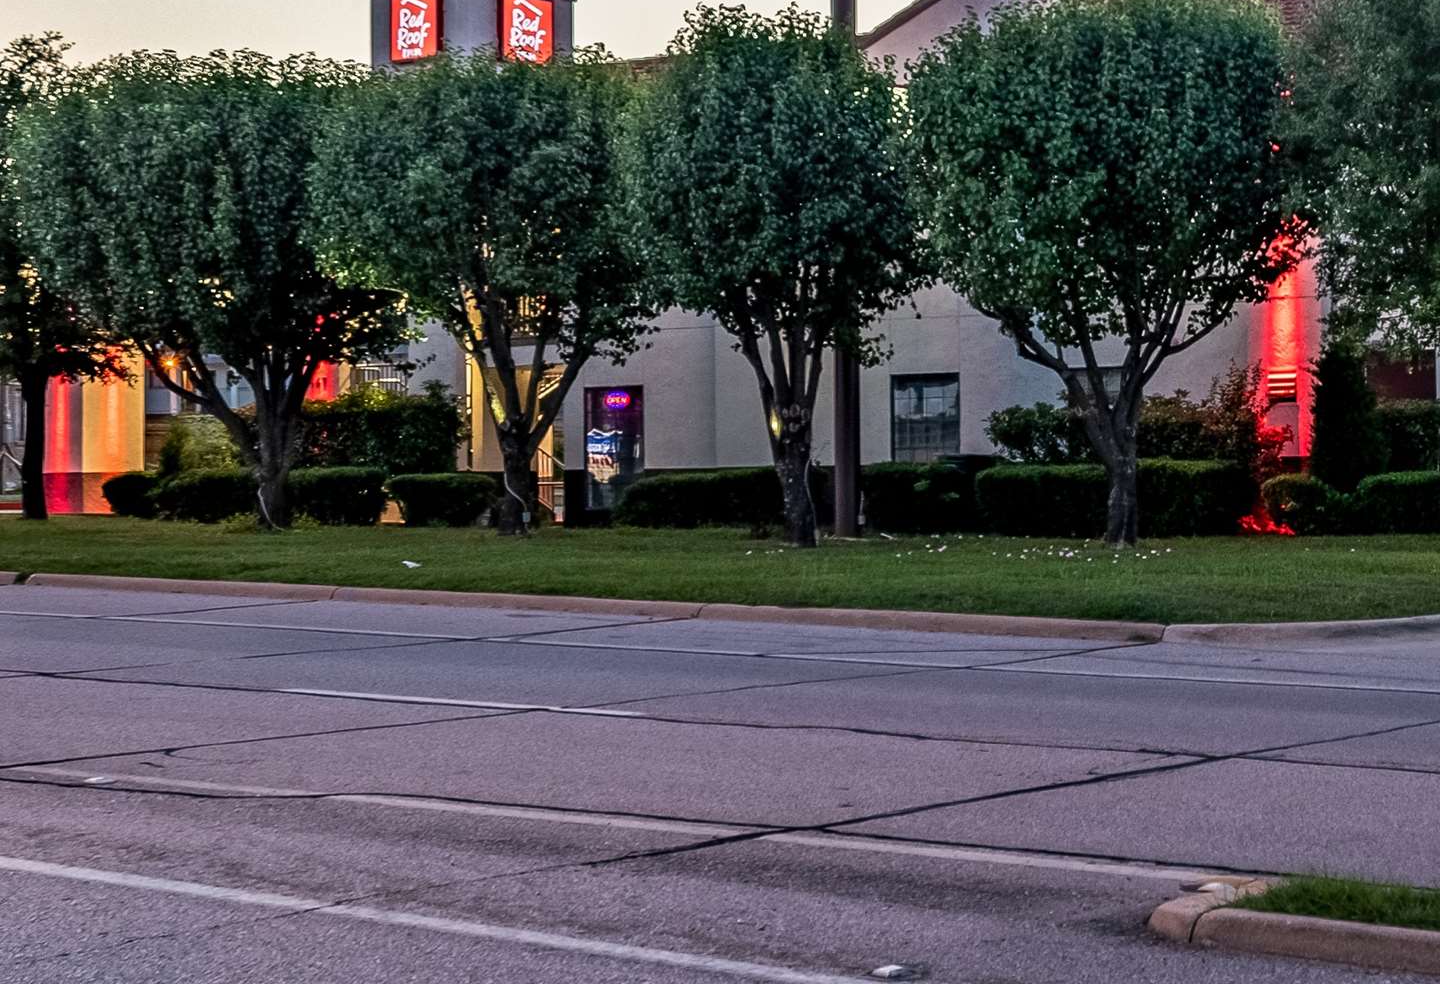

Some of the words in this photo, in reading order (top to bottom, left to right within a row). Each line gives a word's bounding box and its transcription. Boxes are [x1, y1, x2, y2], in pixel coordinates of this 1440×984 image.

[399, 8, 425, 28] Red
[512, 8, 540, 31] Red
[397, 22, 431, 50] Roof
[510, 27, 546, 51] Roof
